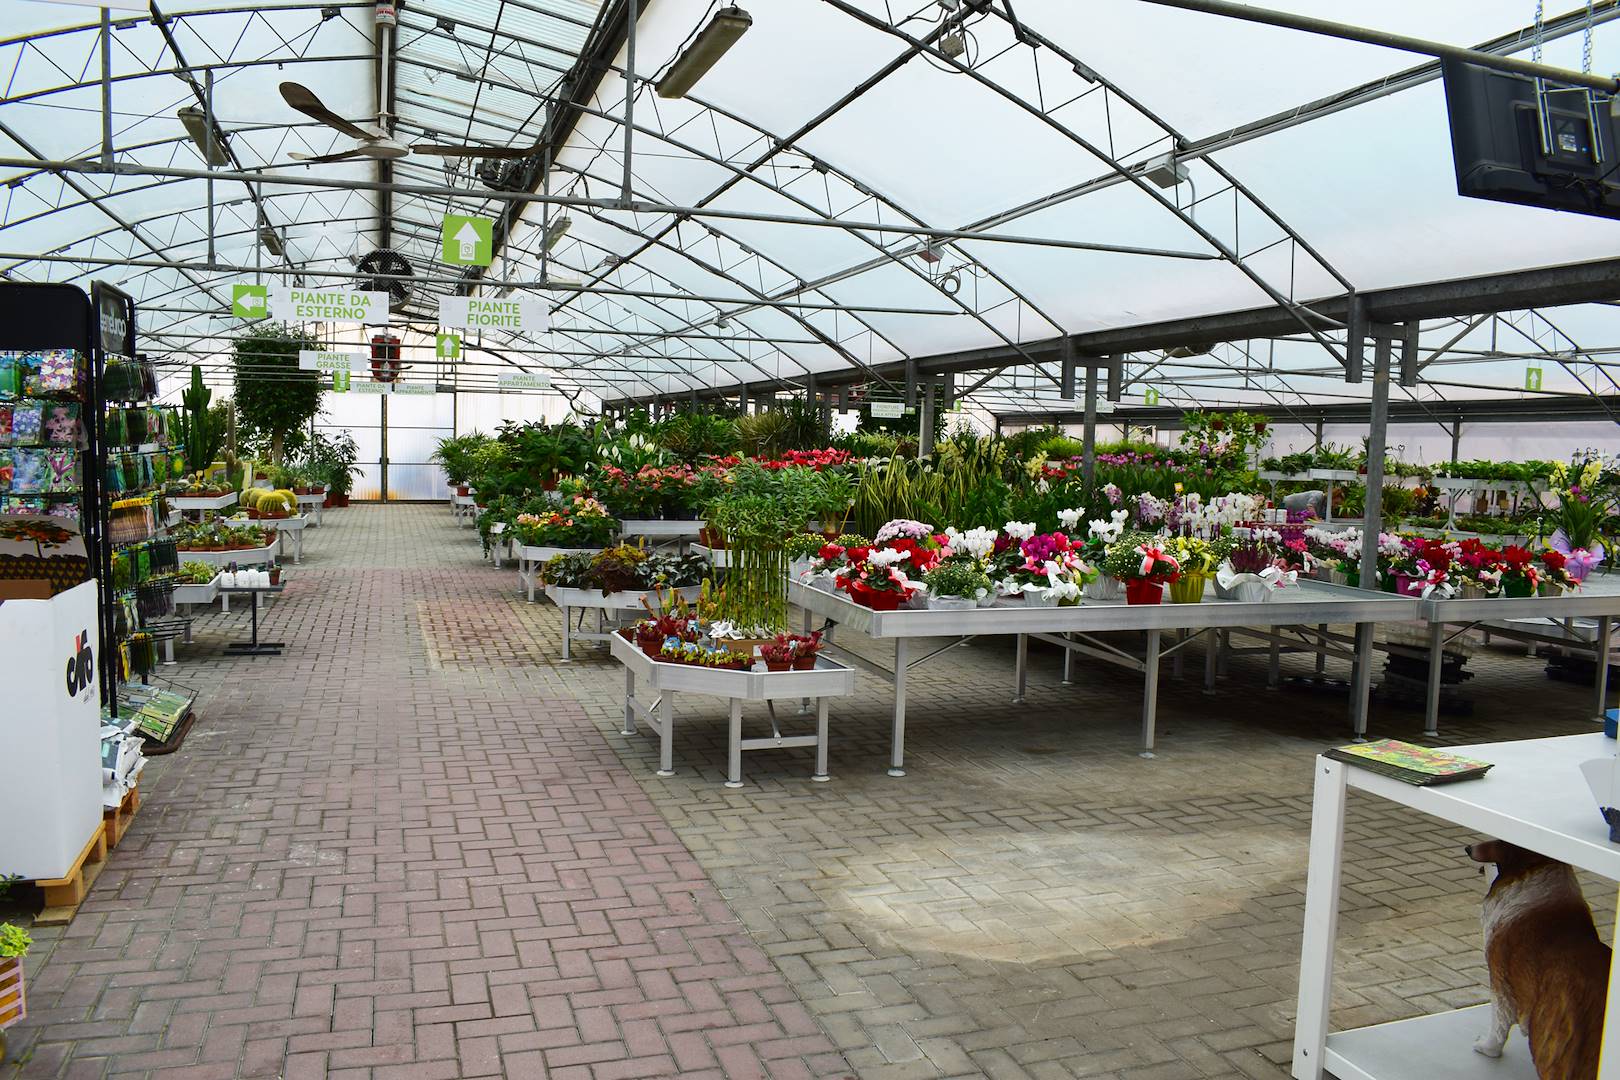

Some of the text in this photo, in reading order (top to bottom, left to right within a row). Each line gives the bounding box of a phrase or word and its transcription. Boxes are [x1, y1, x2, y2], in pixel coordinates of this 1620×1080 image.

[291, 291, 372, 307] PIANTE DA
[296, 305, 366, 320] ESTERNO
[468, 300, 520, 315] PIANTE
[467, 313, 521, 327] FIORITE
[317, 353, 351, 362] PIANTE
[316, 360, 352, 370] GRASSE
[498, 380, 550, 388] APPARTAMENTO
